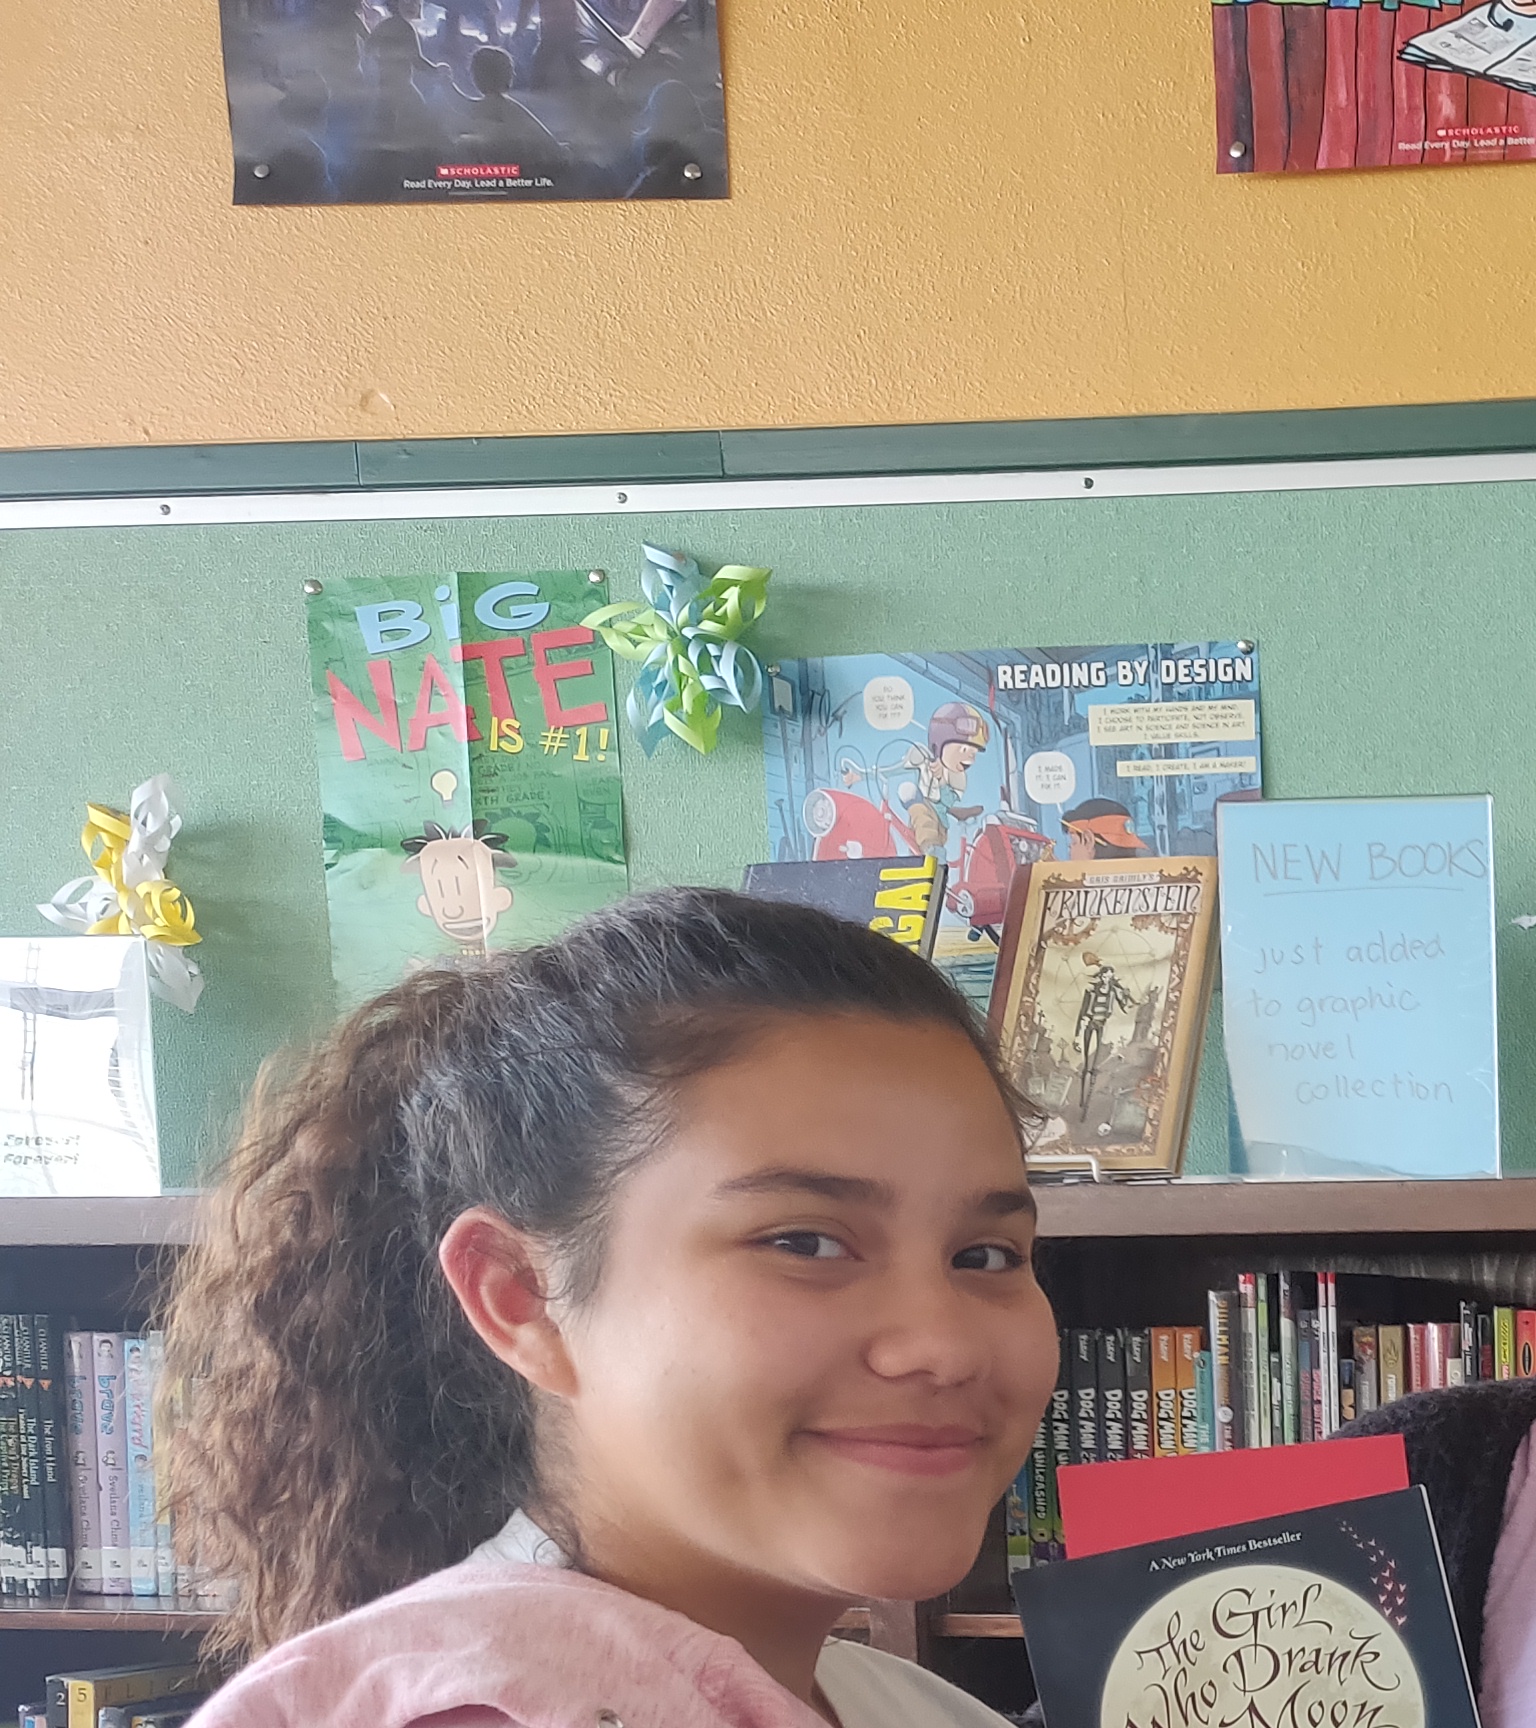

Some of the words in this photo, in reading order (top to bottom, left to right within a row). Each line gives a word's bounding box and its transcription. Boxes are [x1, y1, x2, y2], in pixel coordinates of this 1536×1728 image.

[1447, 125, 1520, 136] SCHOLASTIC
[403, 179, 426, 189] Read
[427, 179, 453, 190] Every
[454, 179, 472, 189] Day.
[475, 178, 496, 188] Lead
[498, 180, 504, 188] a
[506, 177, 533, 188] Better
[535, 177, 554, 187] Life.
[450, 166, 518, 176] SCHOLASTIC
[997, 660, 1107, 692] READING
[1116, 659, 1150, 687] BY
[1161, 656, 1253, 687] DESIGN
[326, 625, 609, 763] NATE
[489, 716, 525, 754] IS
[538, 725, 610, 762] #1!
[1251, 842, 1343, 885] NEW
[1367, 839, 1487, 881] BOOKS
[1041, 884, 1202, 924] FRANKENSTEIN
[1254, 936, 1325, 974] just
[1346, 930, 1446, 964] added
[1250, 988, 1288, 1019] to
[1296, 981, 1420, 1027] graphic
[1267, 1035, 1355, 1062] novel
[1296, 1074, 1454, 1105] collection
[71, 1375, 87, 1435] brave
[99, 1375, 116, 1435] brave
[1077, 1387, 1094, 1418] DOG
[1180, 1388, 1196, 1420] DOG
[27, 1418, 37, 1433] The
[44, 1420, 54, 1435] The
[1078, 1420, 1096, 1448] MAN
[1182, 1418, 1197, 1448] MAN
[1200, 1424, 1210, 1443] THE
[28, 1435, 38, 1456] Dark
[45, 1436, 55, 1455] Iron
[29, 1458, 40, 1485] Island
[108, 1475, 118, 1516] Svetlana
[1149, 1560, 1160, 1572] A
[1161, 1556, 1187, 1570] New
[1187, 1548, 1216, 1563] York
[1214, 1544, 1247, 1558] Times
[1248, 1531, 1302, 1551] Bestseller
[1135, 1611, 1206, 1680] The
[1211, 1583, 1332, 1663] Girl
[1222, 1628, 1400, 1696] Drank
[55, 1692, 65, 1706] 2
[77, 1688, 88, 1703] 5
